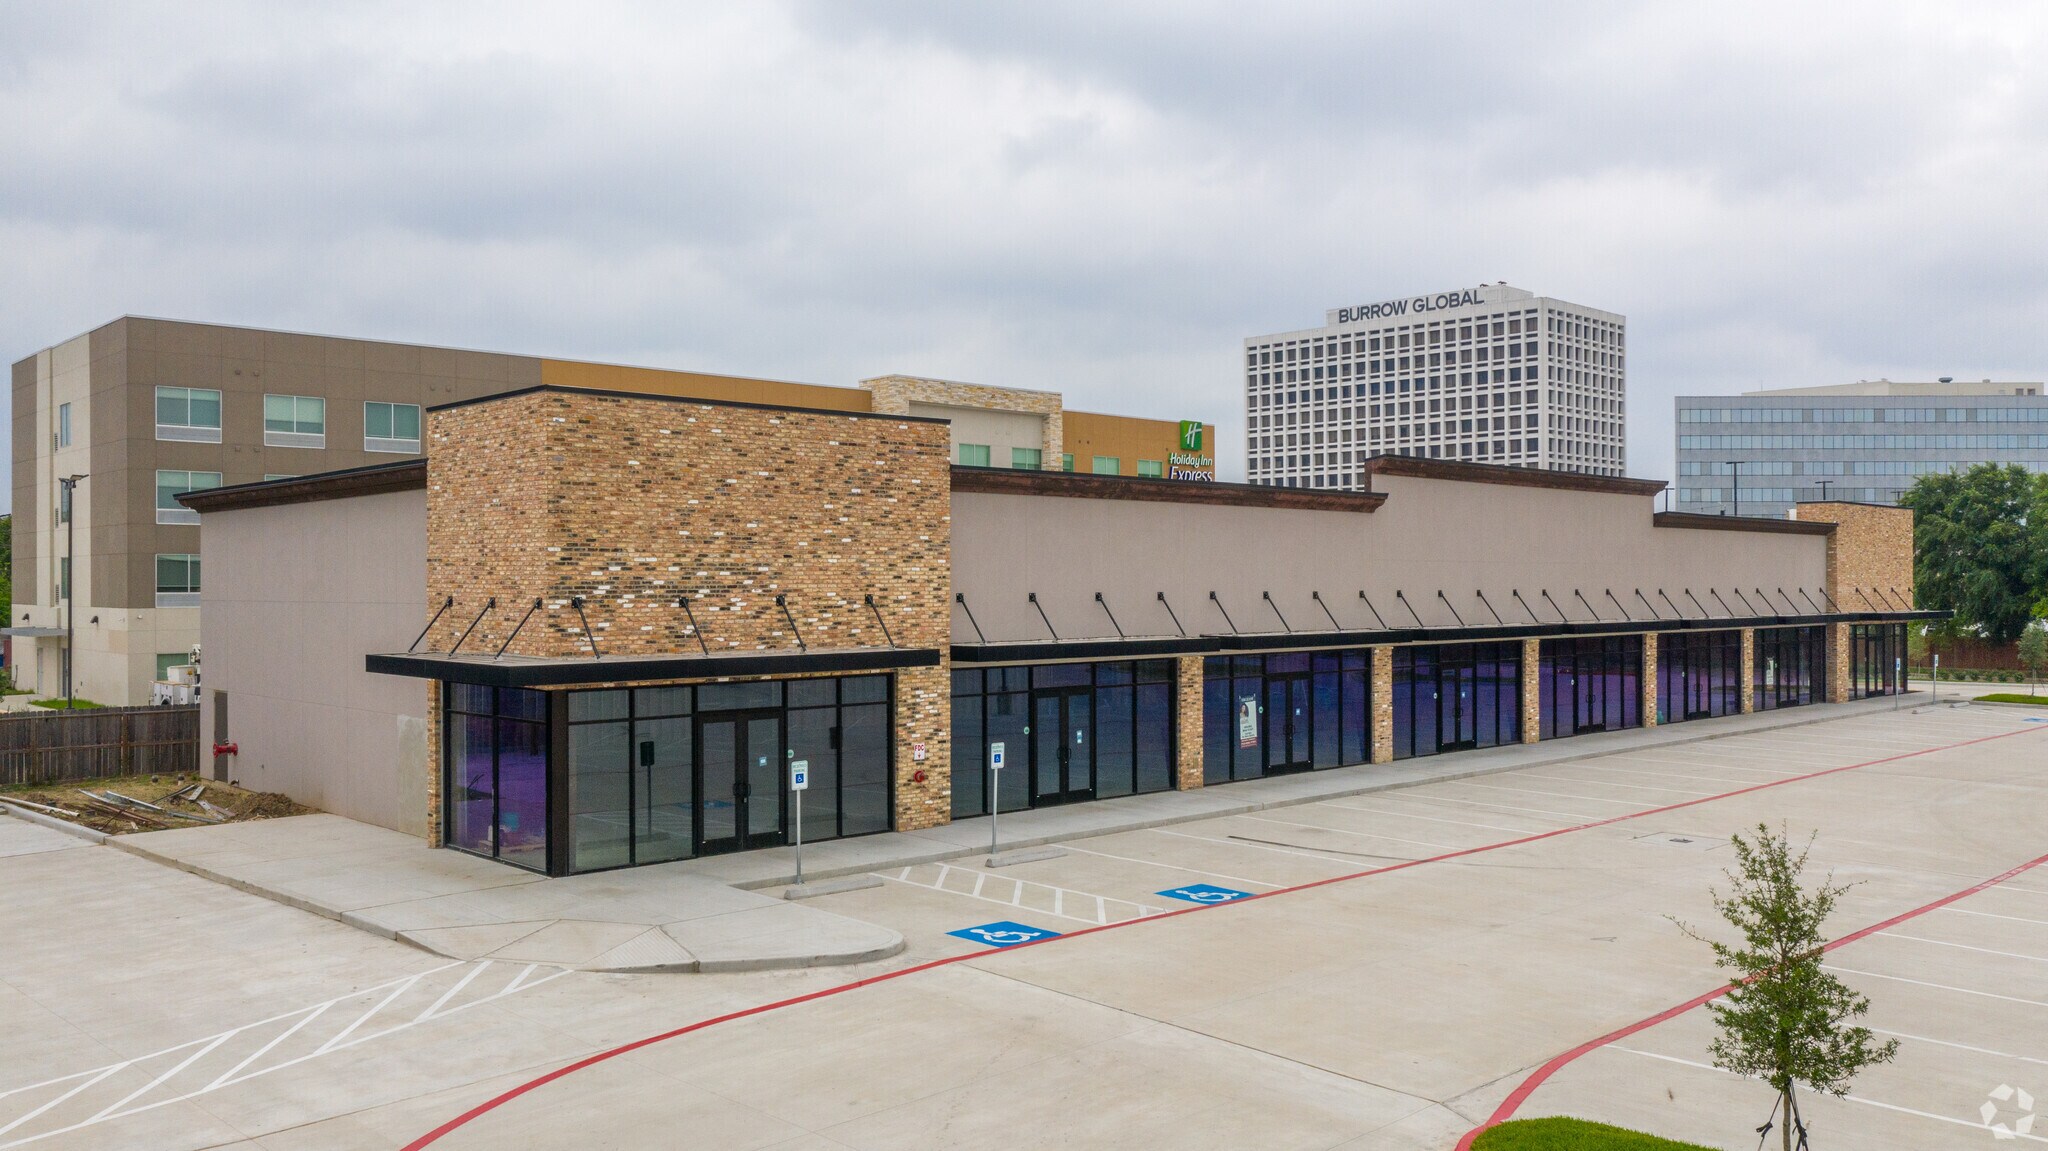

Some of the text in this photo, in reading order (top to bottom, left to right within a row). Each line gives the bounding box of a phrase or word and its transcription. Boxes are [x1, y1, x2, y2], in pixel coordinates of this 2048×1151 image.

[1339, 290, 1484, 323] BURROW GLOBAL
[1169, 452, 1213, 468] Holiday Inn
